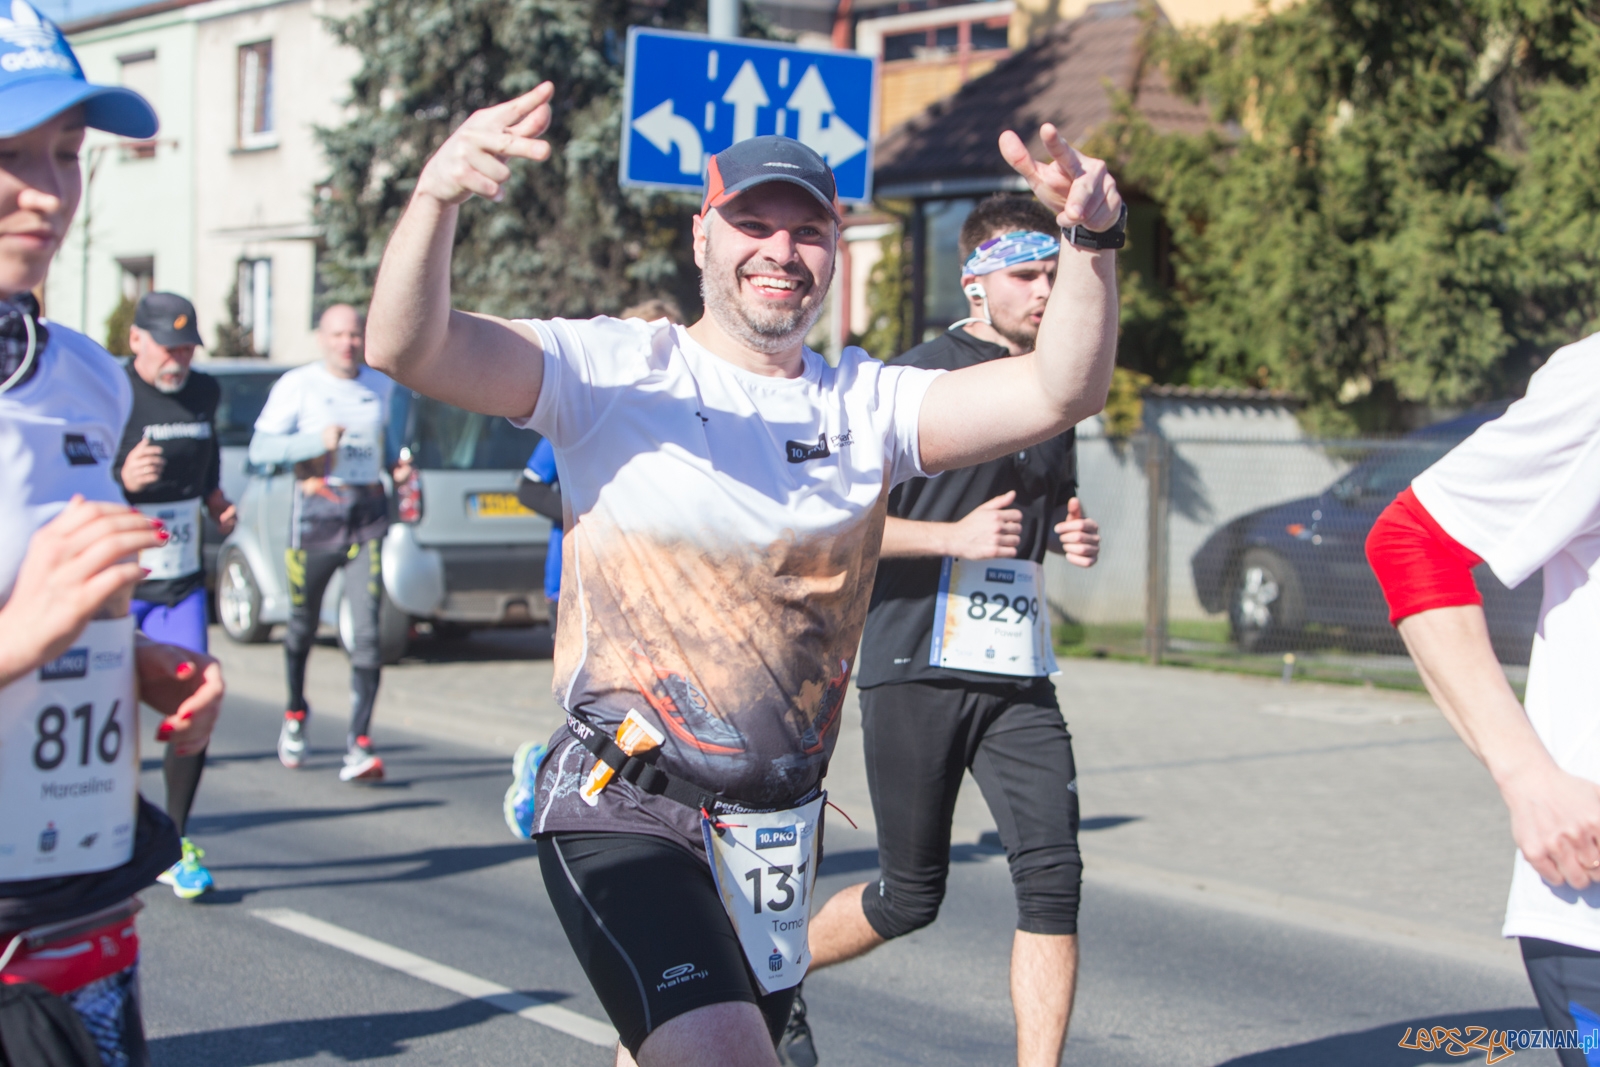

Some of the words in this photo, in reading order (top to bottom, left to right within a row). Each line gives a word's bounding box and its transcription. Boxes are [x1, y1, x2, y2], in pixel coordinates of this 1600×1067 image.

[967, 590, 1038, 627] 8299
[33, 699, 122, 771] 816
[40, 777, 115, 800] Marcelina
